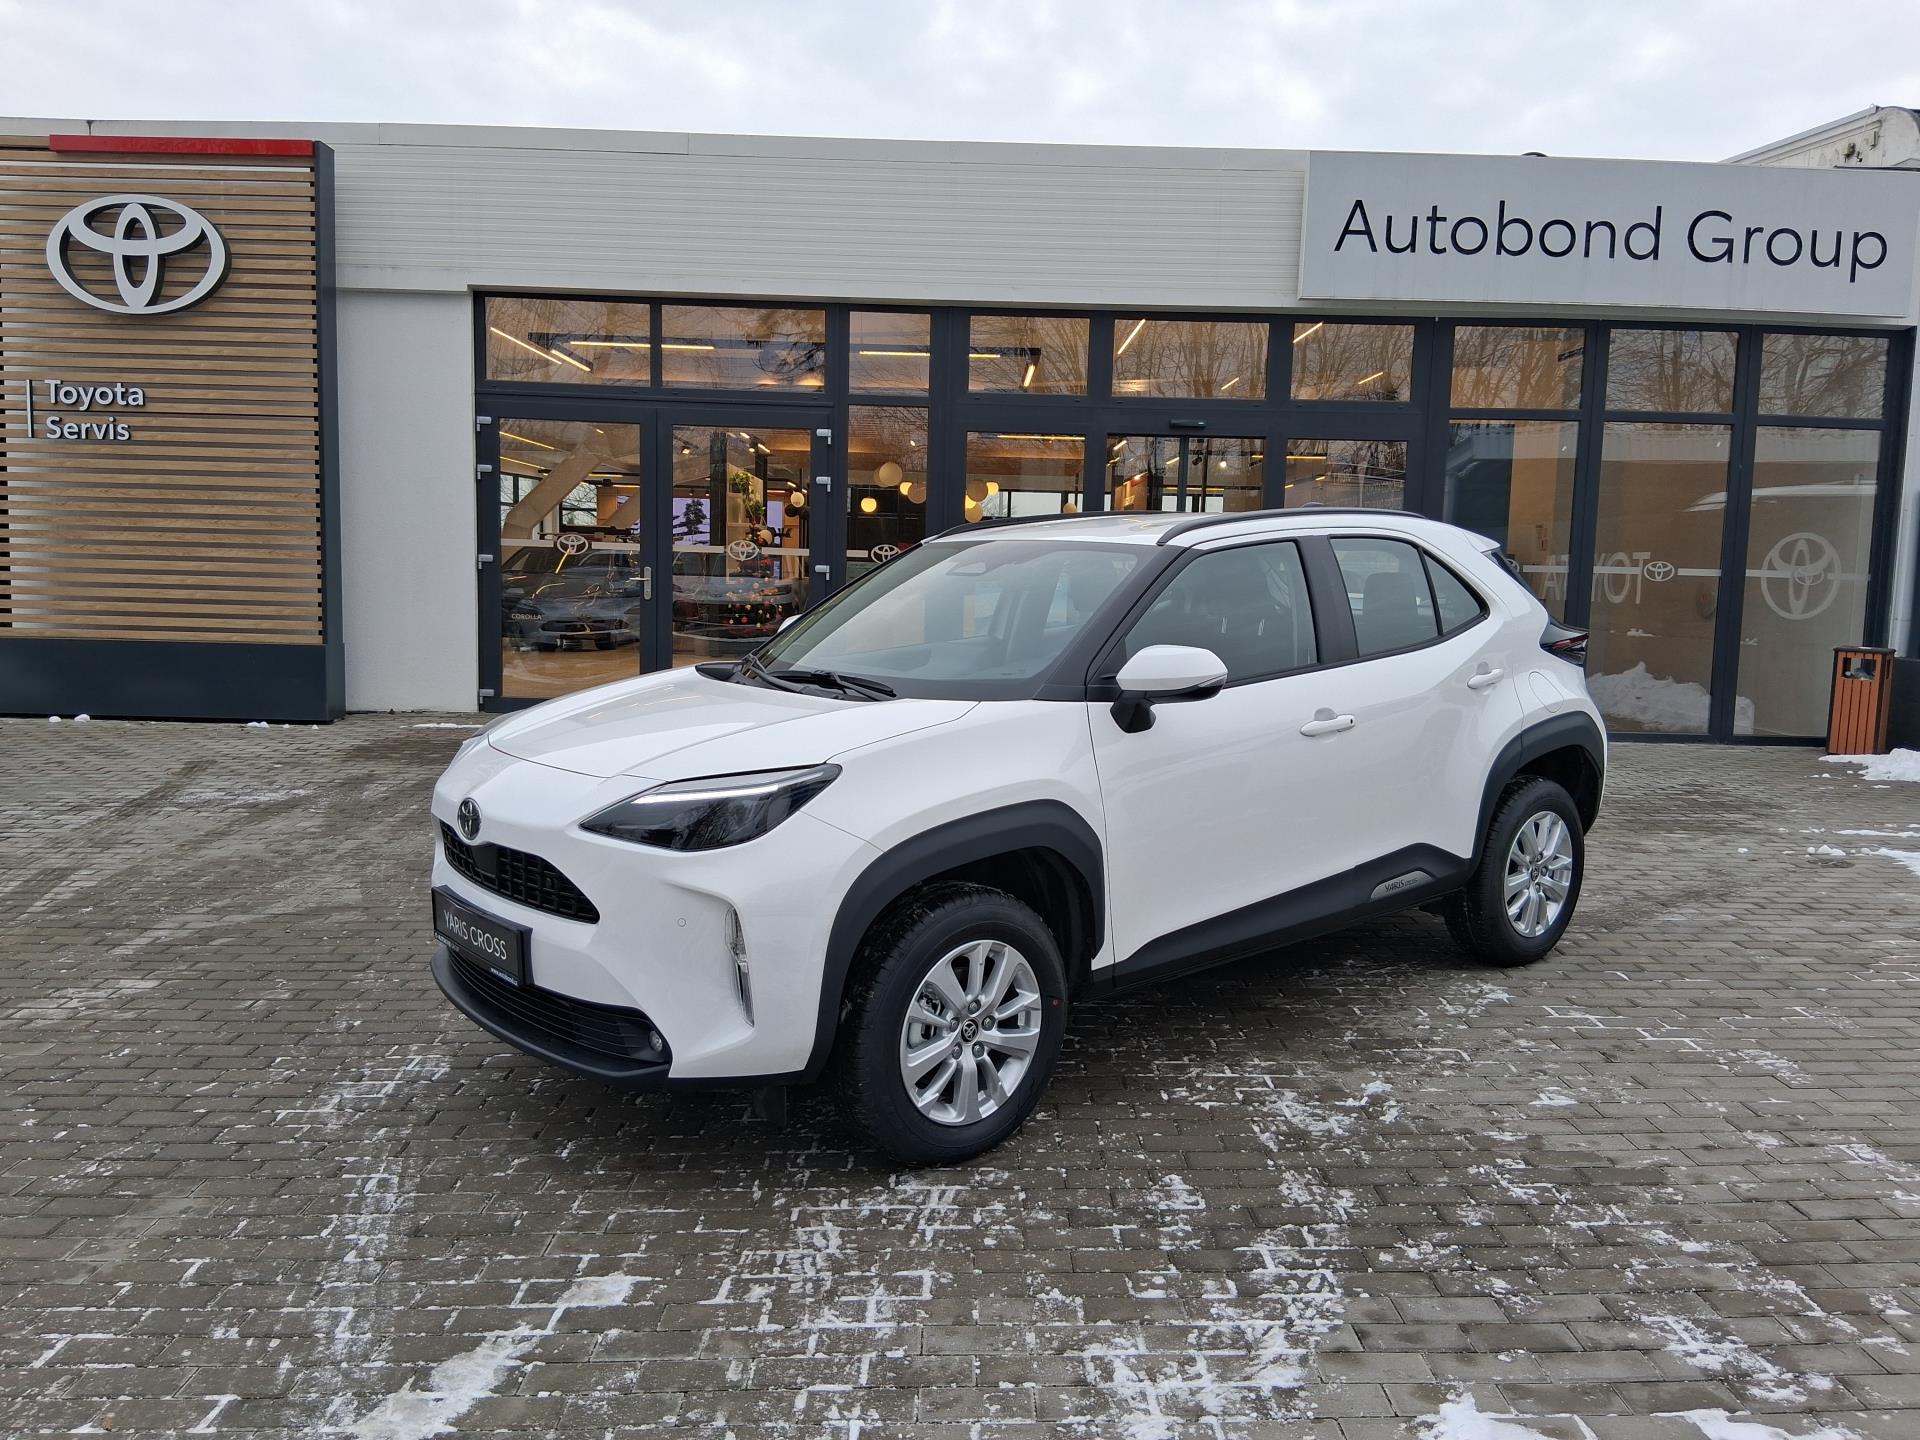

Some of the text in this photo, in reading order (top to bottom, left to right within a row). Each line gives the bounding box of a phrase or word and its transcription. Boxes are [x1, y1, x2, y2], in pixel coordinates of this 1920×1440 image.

[1333, 199, 1888, 284] Autobond Group
[44, 379, 145, 411] Toyota
[45, 416, 130, 441] Servis
[511, 612, 541, 621] COROLLA
[1384, 879, 1405, 893] YARIS
[443, 909, 469, 940] YARIS
[469, 926, 507, 960] CROSS
